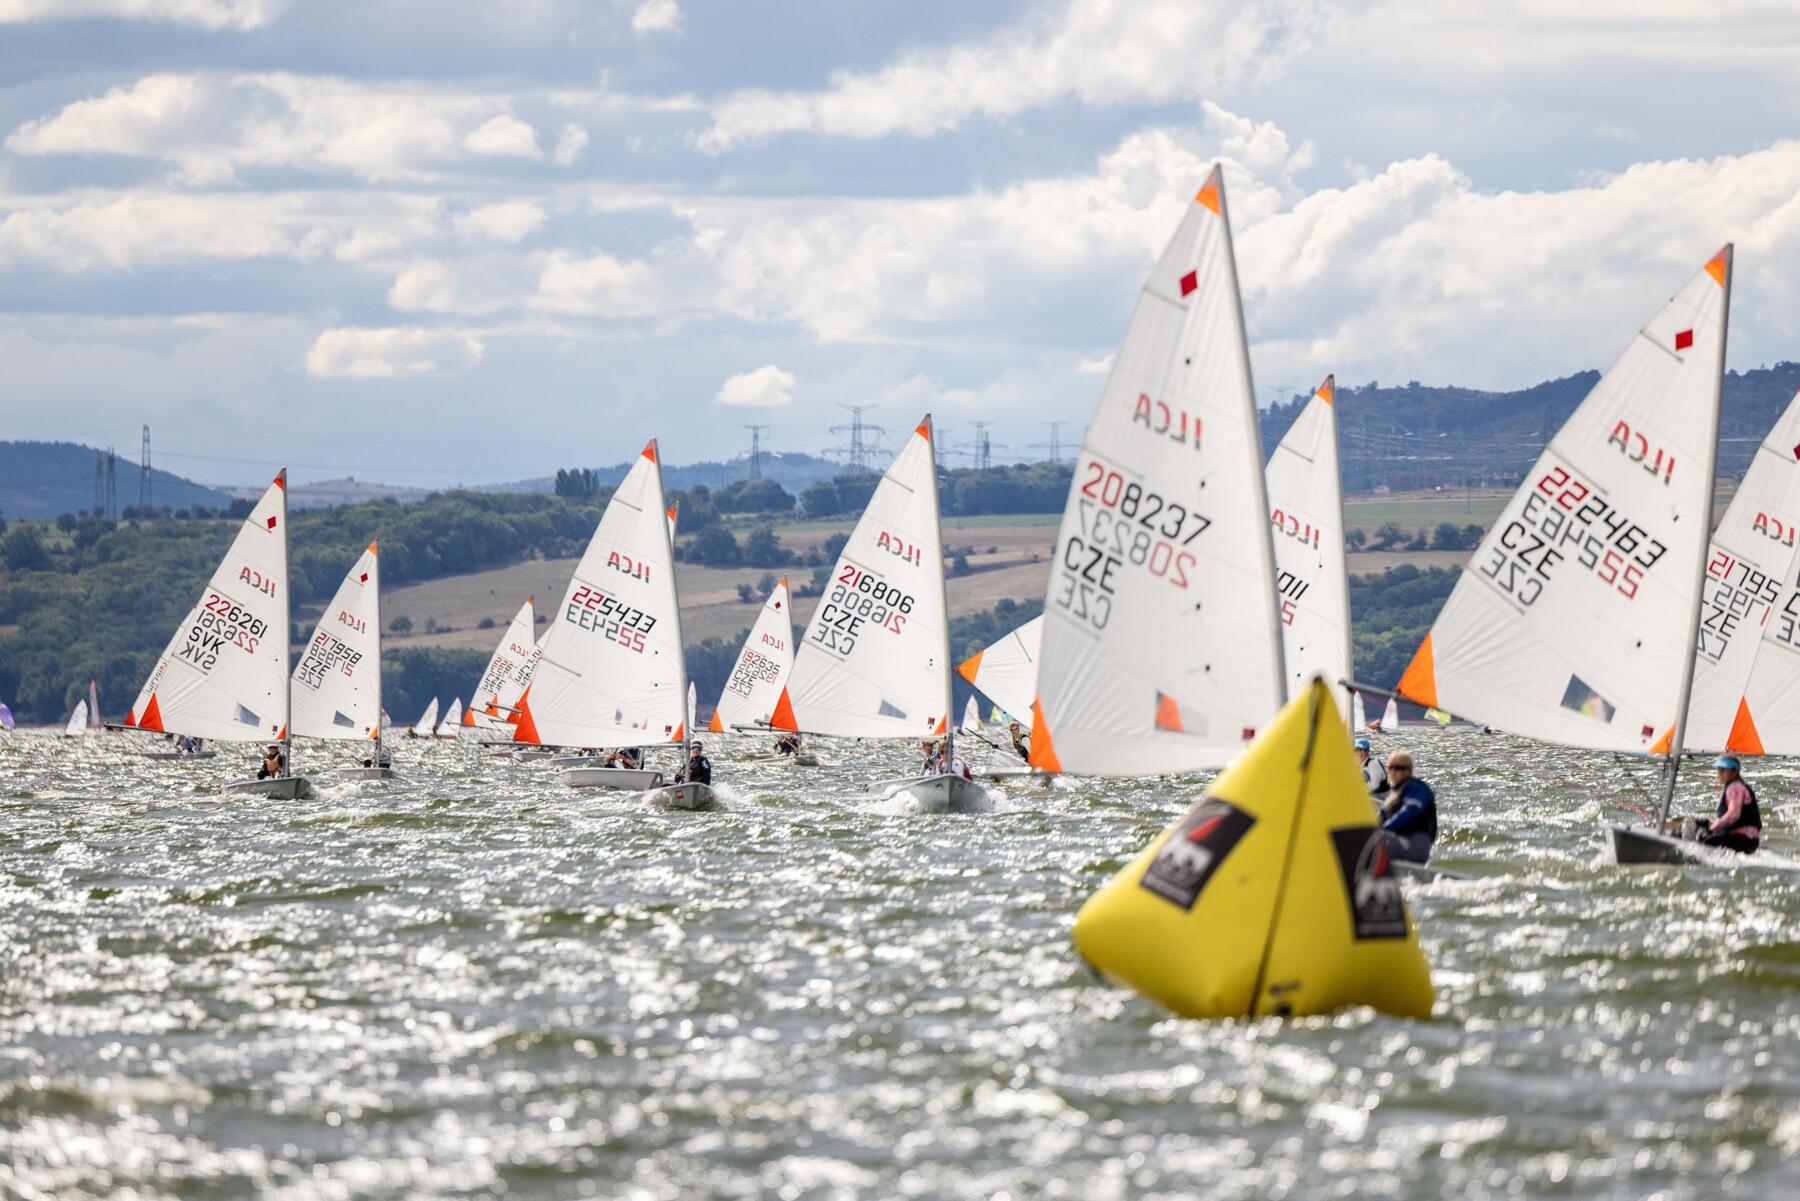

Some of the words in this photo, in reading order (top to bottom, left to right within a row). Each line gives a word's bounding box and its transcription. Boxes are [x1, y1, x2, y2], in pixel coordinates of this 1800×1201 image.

[1082, 462, 1212, 545] 208237
[1537, 466, 1668, 569] 222463
[1064, 537, 1122, 595] CZE
[1500, 522, 1564, 581] CZE
[838, 565, 915, 614] 216806
[1708, 551, 1783, 604] 21795
[205, 594, 268, 639] 226261
[572, 585, 657, 633] 225433
[822, 604, 865, 637] CZE
[1702, 600, 1740, 638] ZE
[189, 626, 226, 655] SVK
[314, 632, 362, 664] 217958
[742, 649, 781, 675] 192635
[302, 655, 331, 677] CZE
[734, 669, 757, 687] CZE
